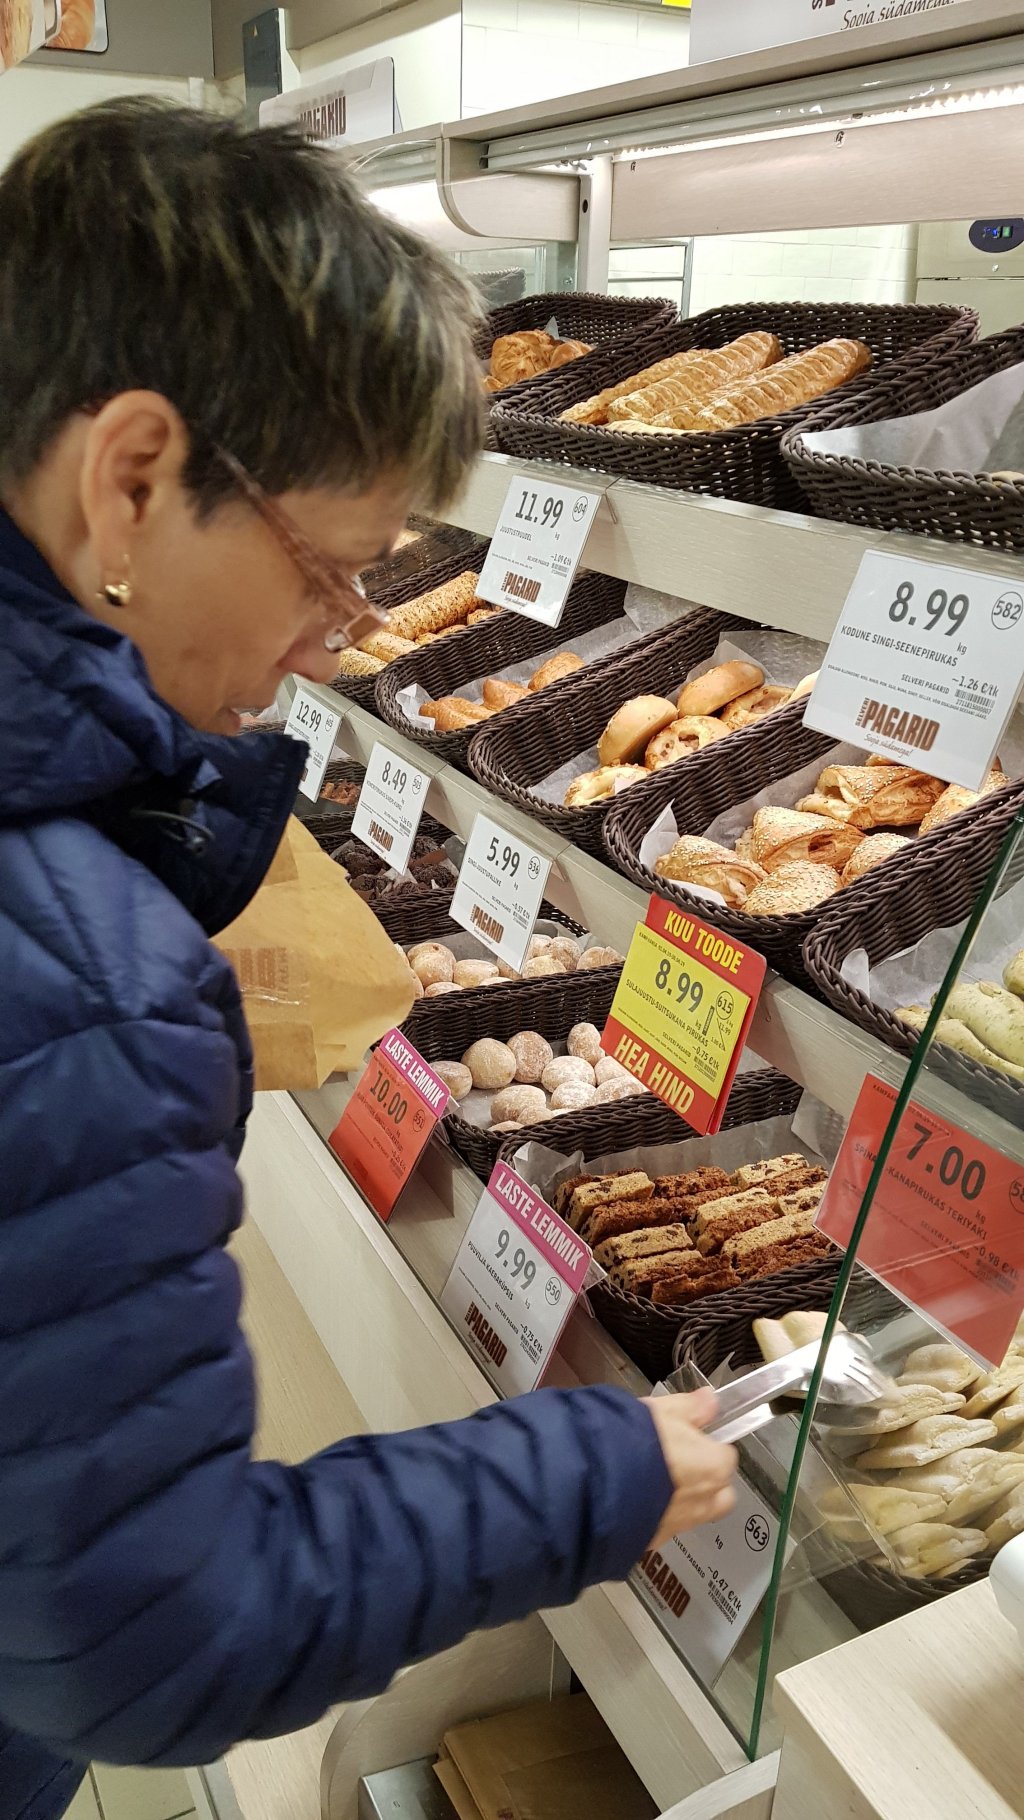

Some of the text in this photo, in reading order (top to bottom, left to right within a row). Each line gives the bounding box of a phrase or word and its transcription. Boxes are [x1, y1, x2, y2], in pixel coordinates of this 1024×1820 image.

[515, 491, 563, 528] 11.99
[503, 572, 541, 602] PAGARID
[889, 582, 968, 635] 8.99
[993, 598, 1021, 621] 582
[840, 625, 957, 666] KODUNE SINGI-SEENEPIRUKAS
[956, 642, 967, 655] kg
[901, 673, 949, 694] SELVERI PAGARID
[980, 682, 998, 696] €/tk
[296, 701, 321, 732] 12.99
[862, 701, 939, 750] PAGARID
[381, 761, 407, 793] 8.49
[486, 837, 520, 876] 5.99
[472, 906, 503, 943] PAGARID
[664, 910, 744, 974] KUU TOODE
[655, 959, 703, 1011] 8.99
[716, 996, 733, 1014] 615
[685, 1025, 708, 1047] PIRUKAS
[694, 1019, 701, 1030] kg
[385, 1034, 413, 1070] LASTE
[407, 1061, 445, 1108] LEMMIK
[613, 1033, 650, 1078] HEA
[647, 1062, 695, 1114] HIND
[692, 1046, 719, 1070] ~0.75 €/tk
[370, 1071, 407, 1124] 10.00
[907, 1123, 985, 1200] 7.00
[495, 1171, 584, 1272] LASTE LEMMIK
[948, 1207, 986, 1240] TERIYAKI
[974, 1209, 986, 1224] kg
[495, 1230, 536, 1289] 9.99
[524, 1298, 530, 1310] kg
[545, 1280, 561, 1301] 550
[467, 1304, 507, 1368] PAGARID
[714, 1534, 723, 1550] kg
[745, 1516, 769, 1544] 563
[672, 1535, 705, 1578] ELVERI PAGARID
[640, 1549, 691, 1618] AGARID
[707, 1566, 741, 1611] ~0.47 €/tk
